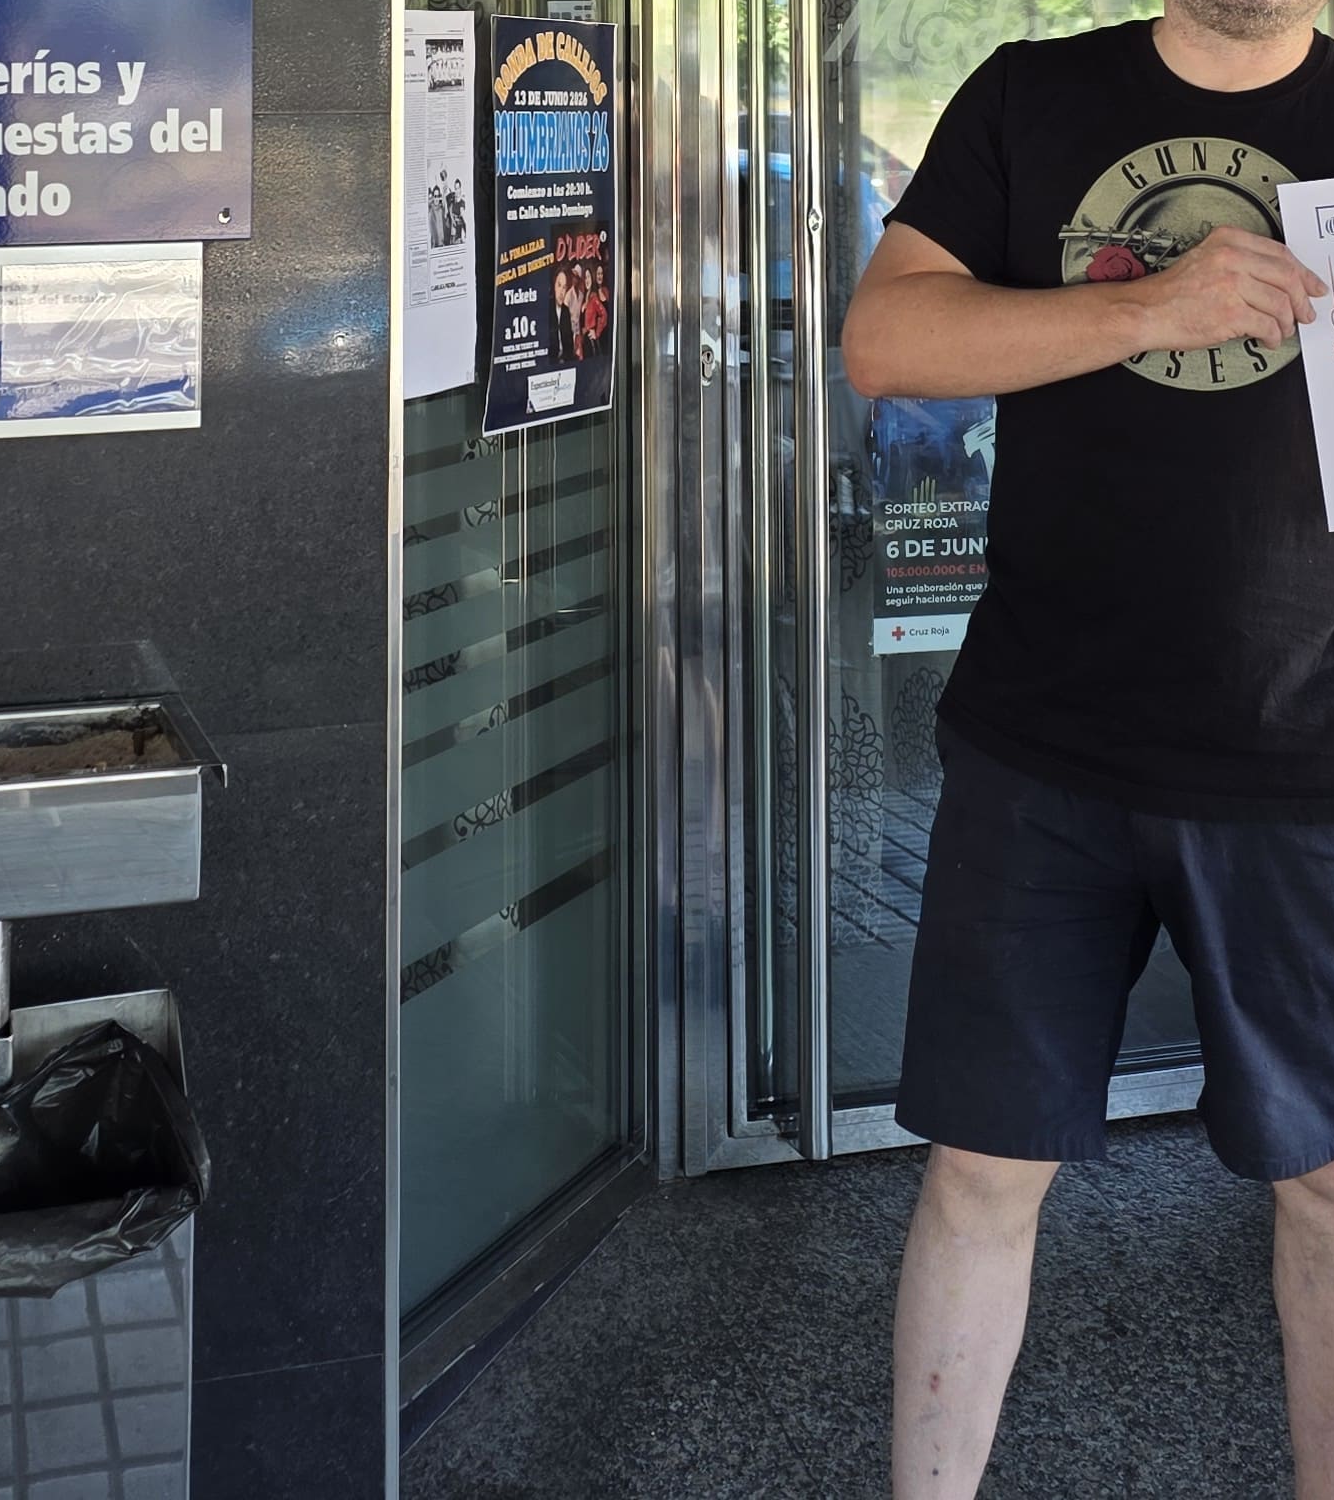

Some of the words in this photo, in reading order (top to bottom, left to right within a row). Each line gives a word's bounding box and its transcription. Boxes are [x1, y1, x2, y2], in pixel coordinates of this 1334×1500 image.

[536, 31, 555, 62] DE
[117, 57, 146, 107] y
[514, 90, 526, 106] 13
[528, 91, 541, 106] DE
[542, 91, 568, 106] JUNIO
[569, 91, 588, 106] 2026
[149, 107, 223, 155] del
[1121, 141, 1248, 190] GUNS
[504, 287, 537, 306] Tickets
[504, 328, 511, 340] a
[513, 315, 529, 339] 10
[1129, 337, 1268, 383] SES
[884, 502, 937, 515] SORTEO
[885, 518, 921, 531] CRUZ
[924, 517, 958, 529] ROJA
[886, 540, 899, 559] 6
[905, 539, 936, 558] DE
[886, 586, 904, 595] Una
[905, 582, 964, 594] colaboración
[965, 583, 983, 592] que
[885, 596, 914, 607] seguir
[915, 593, 958, 604] haciendo
[909, 628, 929, 636] Cruz
[931, 626, 950, 637] Roja
